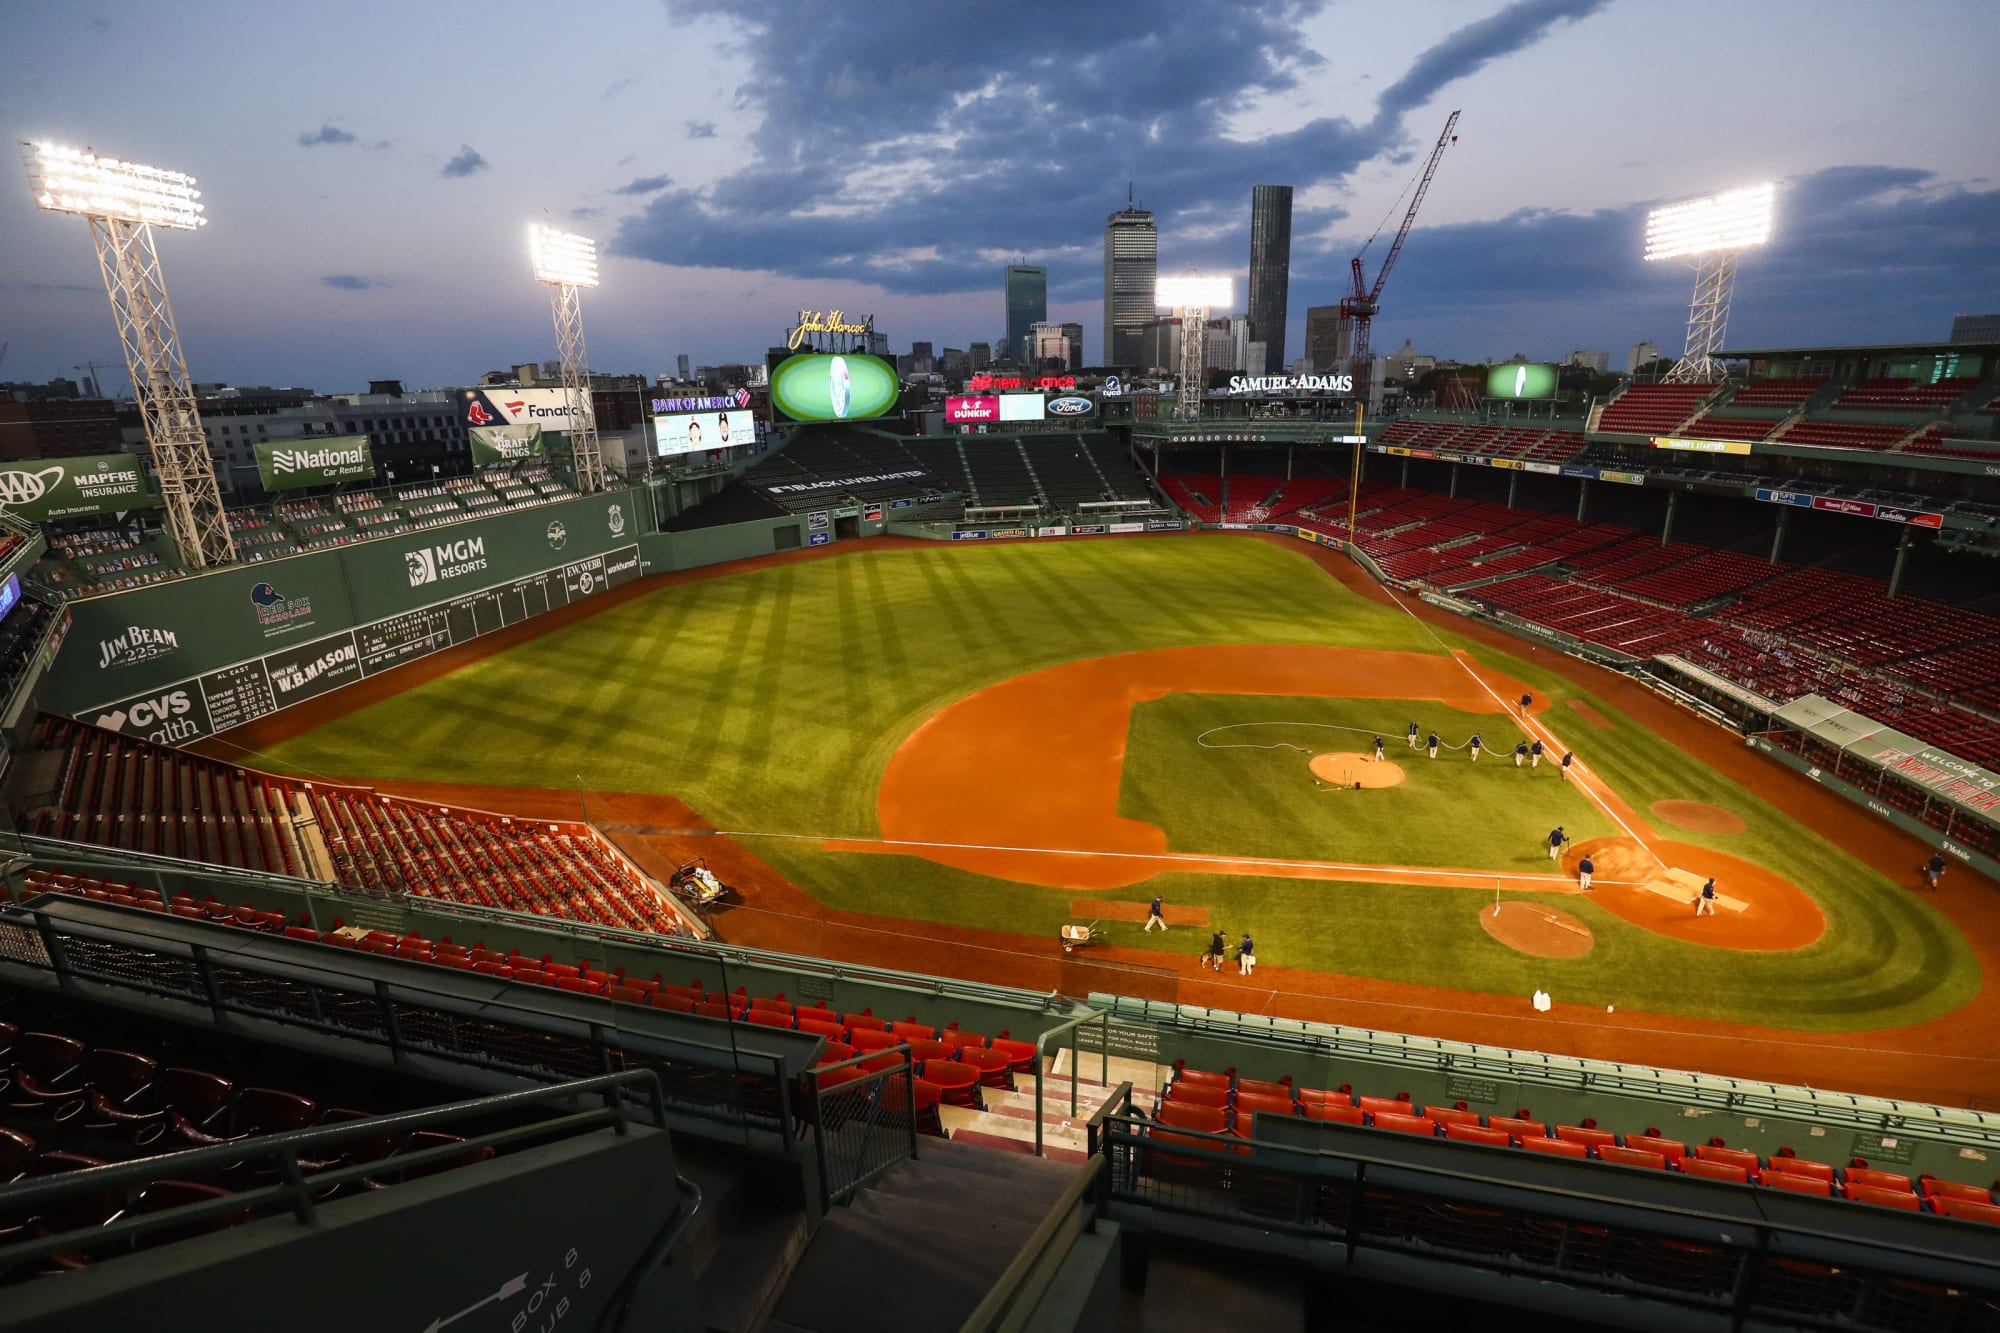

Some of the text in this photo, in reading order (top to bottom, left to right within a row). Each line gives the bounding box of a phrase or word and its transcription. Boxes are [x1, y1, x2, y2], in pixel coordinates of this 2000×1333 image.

[788, 309, 824, 350] John
[993, 378, 1020, 389] new
[1021, 376, 1075, 388] balance
[1229, 373, 1353, 394] SAMUEL ADAMS
[528, 405, 580, 417] Fanatc
[653, 396, 736, 412] BANK OF AMERICA
[1056, 401, 1083, 412] Ford
[954, 409, 992, 418] DUNKIN'
[496, 438, 529, 450] DRAFT
[294, 446, 363, 469] National
[501, 447, 530, 459] KINGS
[73, 470, 138, 486] MAPFRE
[323, 465, 363, 477] Car Rental
[791, 470, 927, 491] BLACK LIVES MATTER
[82, 484, 138, 498] INSURANCE
[1780, 492, 1795, 500] TUFTS
[48, 504, 100, 516] Auto Insurance
[1880, 511, 1907, 521] Safelite
[436, 536, 485, 566] MGM
[440, 558, 488, 580] RESORTS
[581, 558, 602, 572] WEBB
[607, 559, 637, 575] workhuman
[261, 597, 311, 617] RED SOX
[373, 617, 403, 631] FENWAY
[99, 626, 179, 669] JIM BEAM
[125, 644, 158, 661] 225
[230, 666, 249, 676] EAST
[271, 664, 298, 680] WHO BUT
[327, 668, 344, 677] SINCE
[208, 692, 224, 702] TAMPA
[223, 689, 234, 697] BAY
[209, 701, 221, 709] NEW
[220, 696, 236, 705] YORK
[129, 691, 191, 727] CVS
[211, 704, 237, 716] TORONTO
[213, 710, 241, 723] BALTIMORE
[215, 720, 237, 731] BOSTON
[1921, 751, 1994, 788] WELCOME TO
[1871, 747, 2000, 812] FENWAY PARK
[579, 1268, 591, 1289] 8
[511, 1247, 578, 1333] BOX 8
